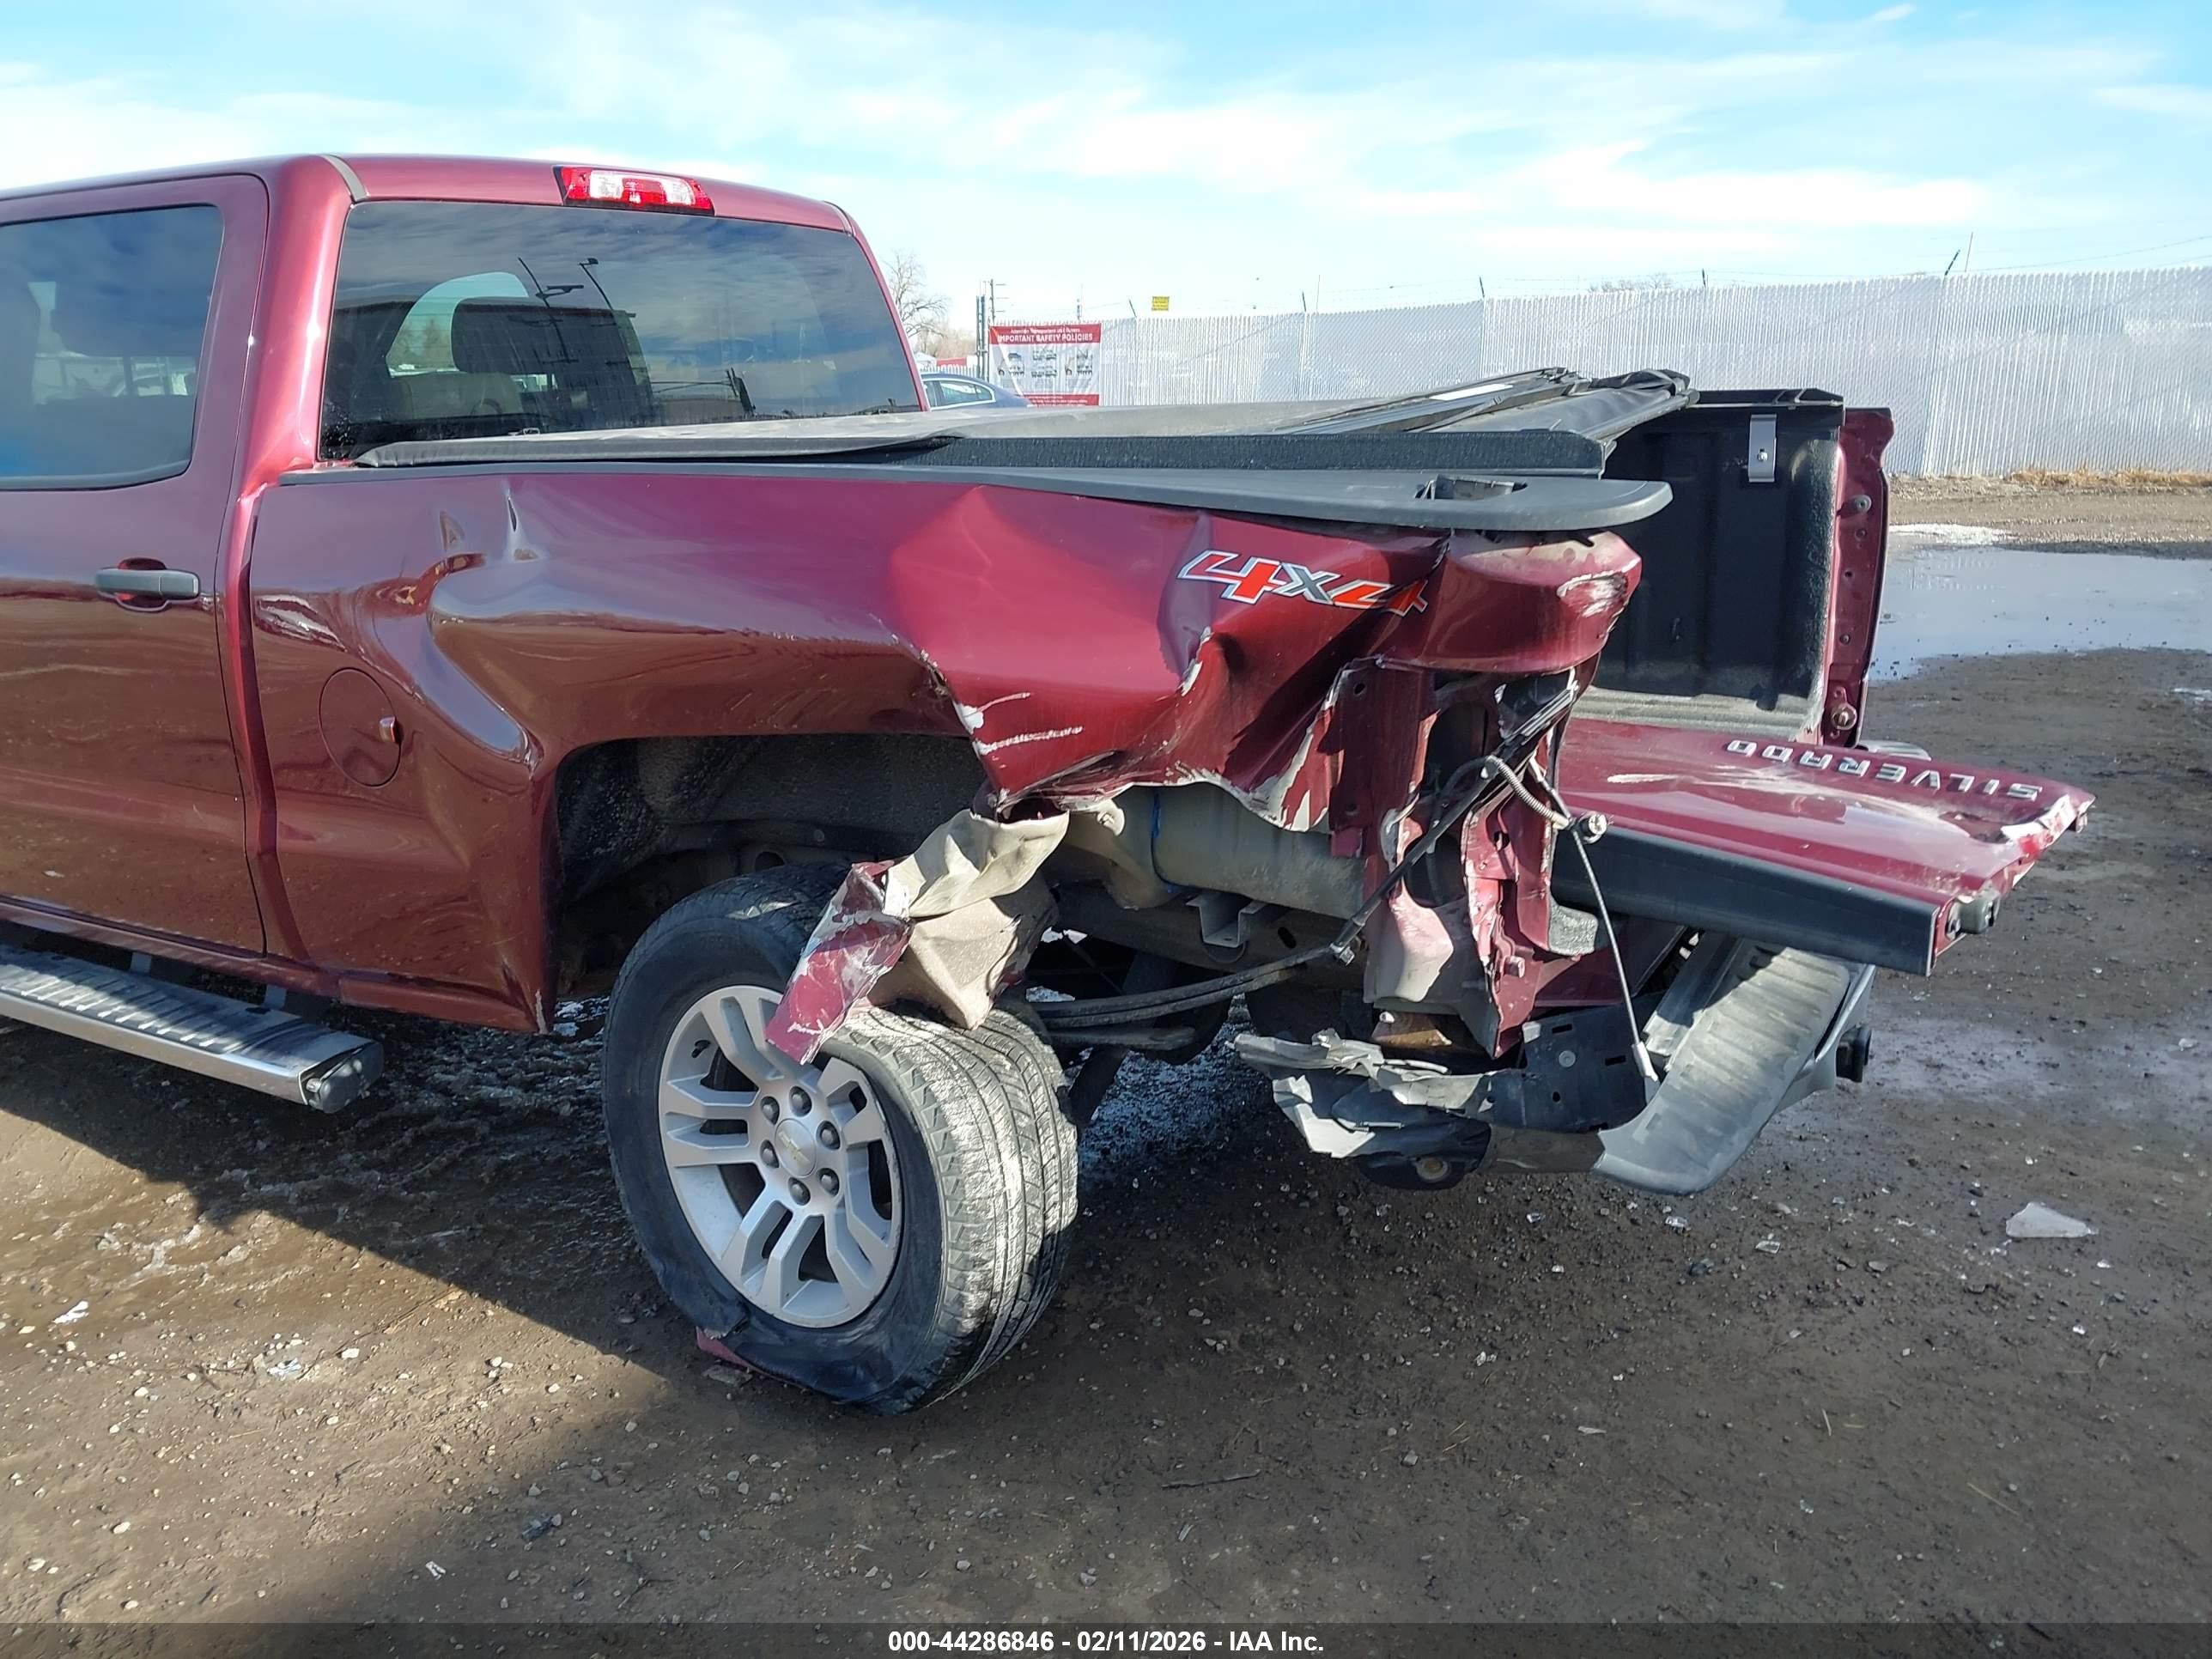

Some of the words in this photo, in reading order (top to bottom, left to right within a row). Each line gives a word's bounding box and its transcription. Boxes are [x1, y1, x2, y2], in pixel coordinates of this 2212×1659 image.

[997, 334, 1035, 343] IMPORTANT
[1036, 333, 1060, 342] SAFETY
[1061, 332, 1093, 342] POLICIES
[1726, 739, 2043, 802] SILVERADO
